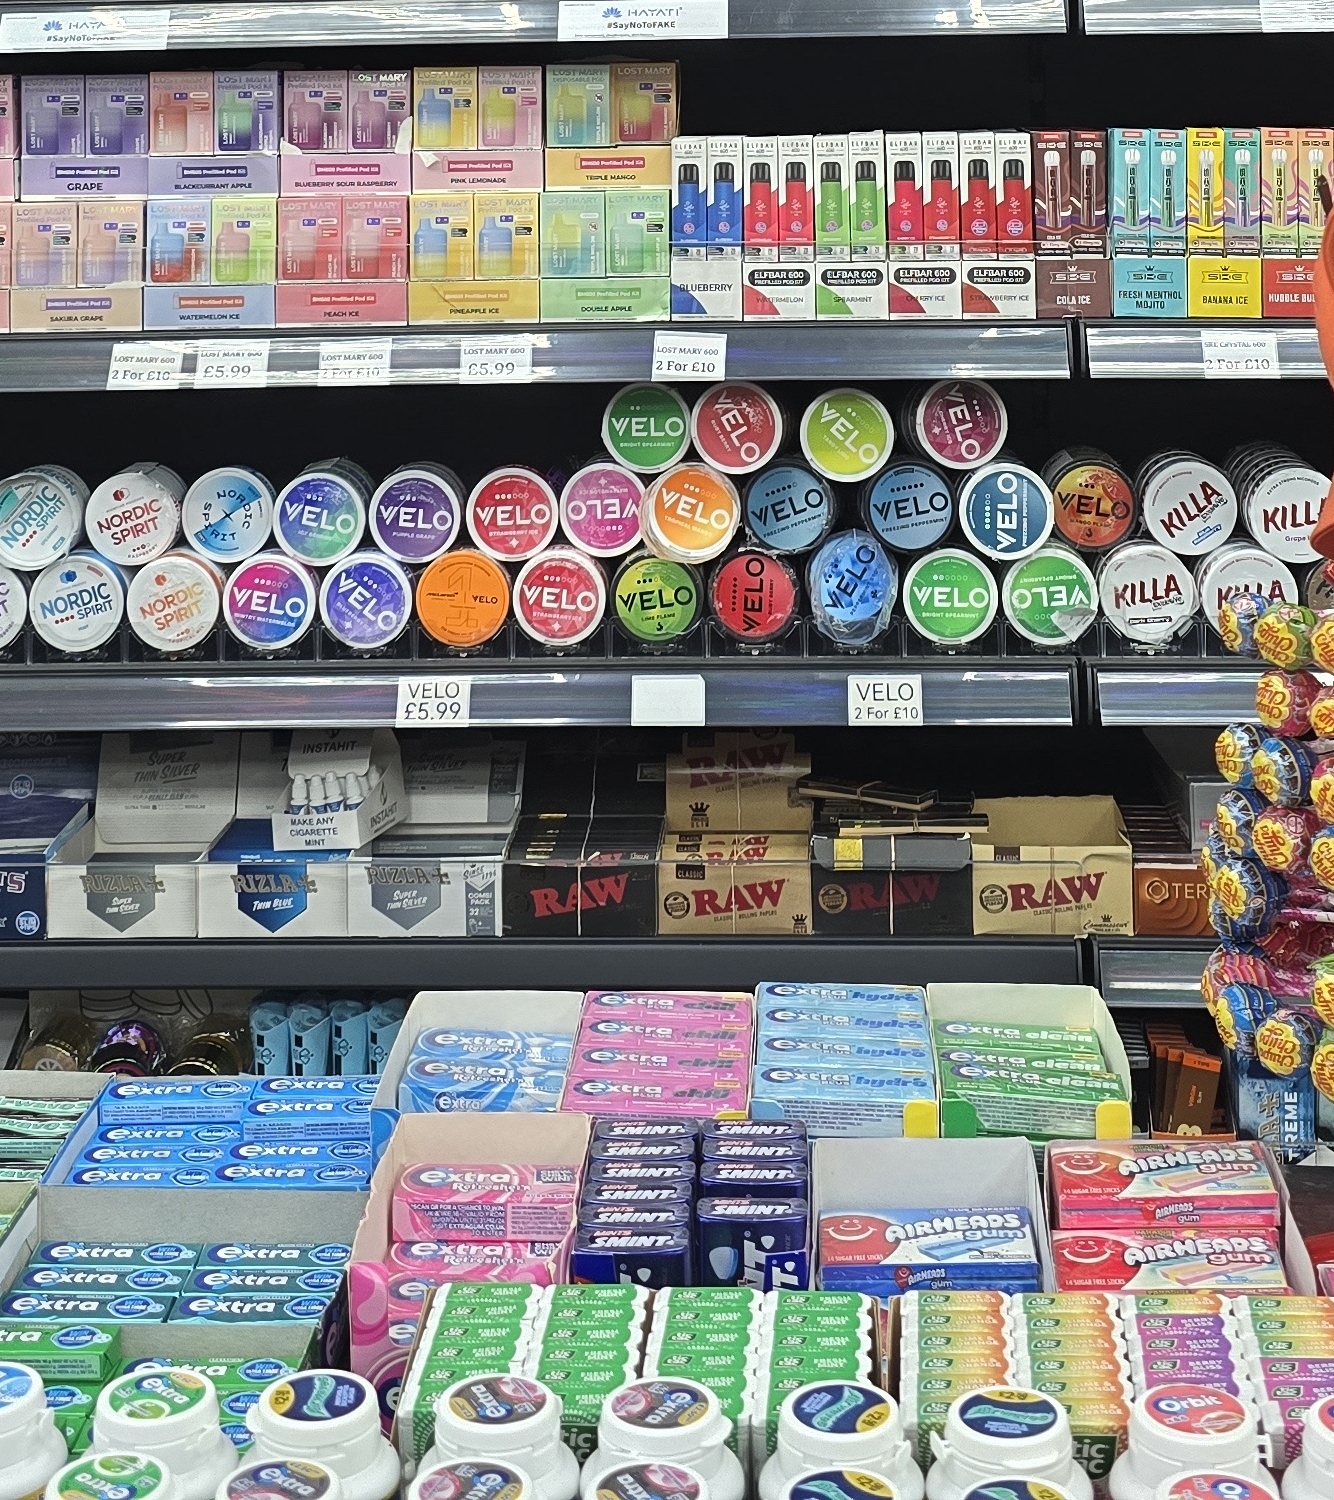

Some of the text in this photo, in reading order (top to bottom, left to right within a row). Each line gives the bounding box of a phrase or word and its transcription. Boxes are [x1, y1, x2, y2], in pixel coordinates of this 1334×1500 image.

[67, 182, 104, 192] GRAPE
[755, 270, 804, 280] ELFBAR 600
[1118, 290, 1182, 301] FRESH MENTHOL
[1135, 299, 1165, 310] MOJITO
[179, 312, 240, 321] WATERMELON ICE
[657, 347, 719, 356] LOST MARY 600
[203, 363, 252, 381] £5.99
[656, 360, 716, 373] 2 For £10
[610, 417, 684, 438] VELO
[97, 499, 161, 535] NORDIC
[284, 500, 355, 535] VELO
[476, 503, 551, 527] VELO
[1159, 481, 1224, 538] KILLA
[110, 517, 160, 546] SPIRIT
[618, 586, 693, 612] VELO
[407, 682, 460, 699] VELO
[855, 683, 914, 701] VELO
[404, 703, 461, 721] £5.99
[854, 706, 919, 721] 2 For £10
[302, 739, 359, 755] INSTAHIT
[290, 817, 335, 827] MAKE ANY
[289, 828, 339, 837] CIGARETTE
[304, 837, 326, 847] MINT
[690, 879, 786, 915] RAW
[1010, 872, 1106, 912] RAW
[946, 1023, 1093, 1043] extra clean
[420, 1170, 511, 1184] extra
[885, 1213, 1022, 1241] AIRHEADS
[963, 1228, 1024, 1241] gum
[41, 1244, 134, 1262] extra
